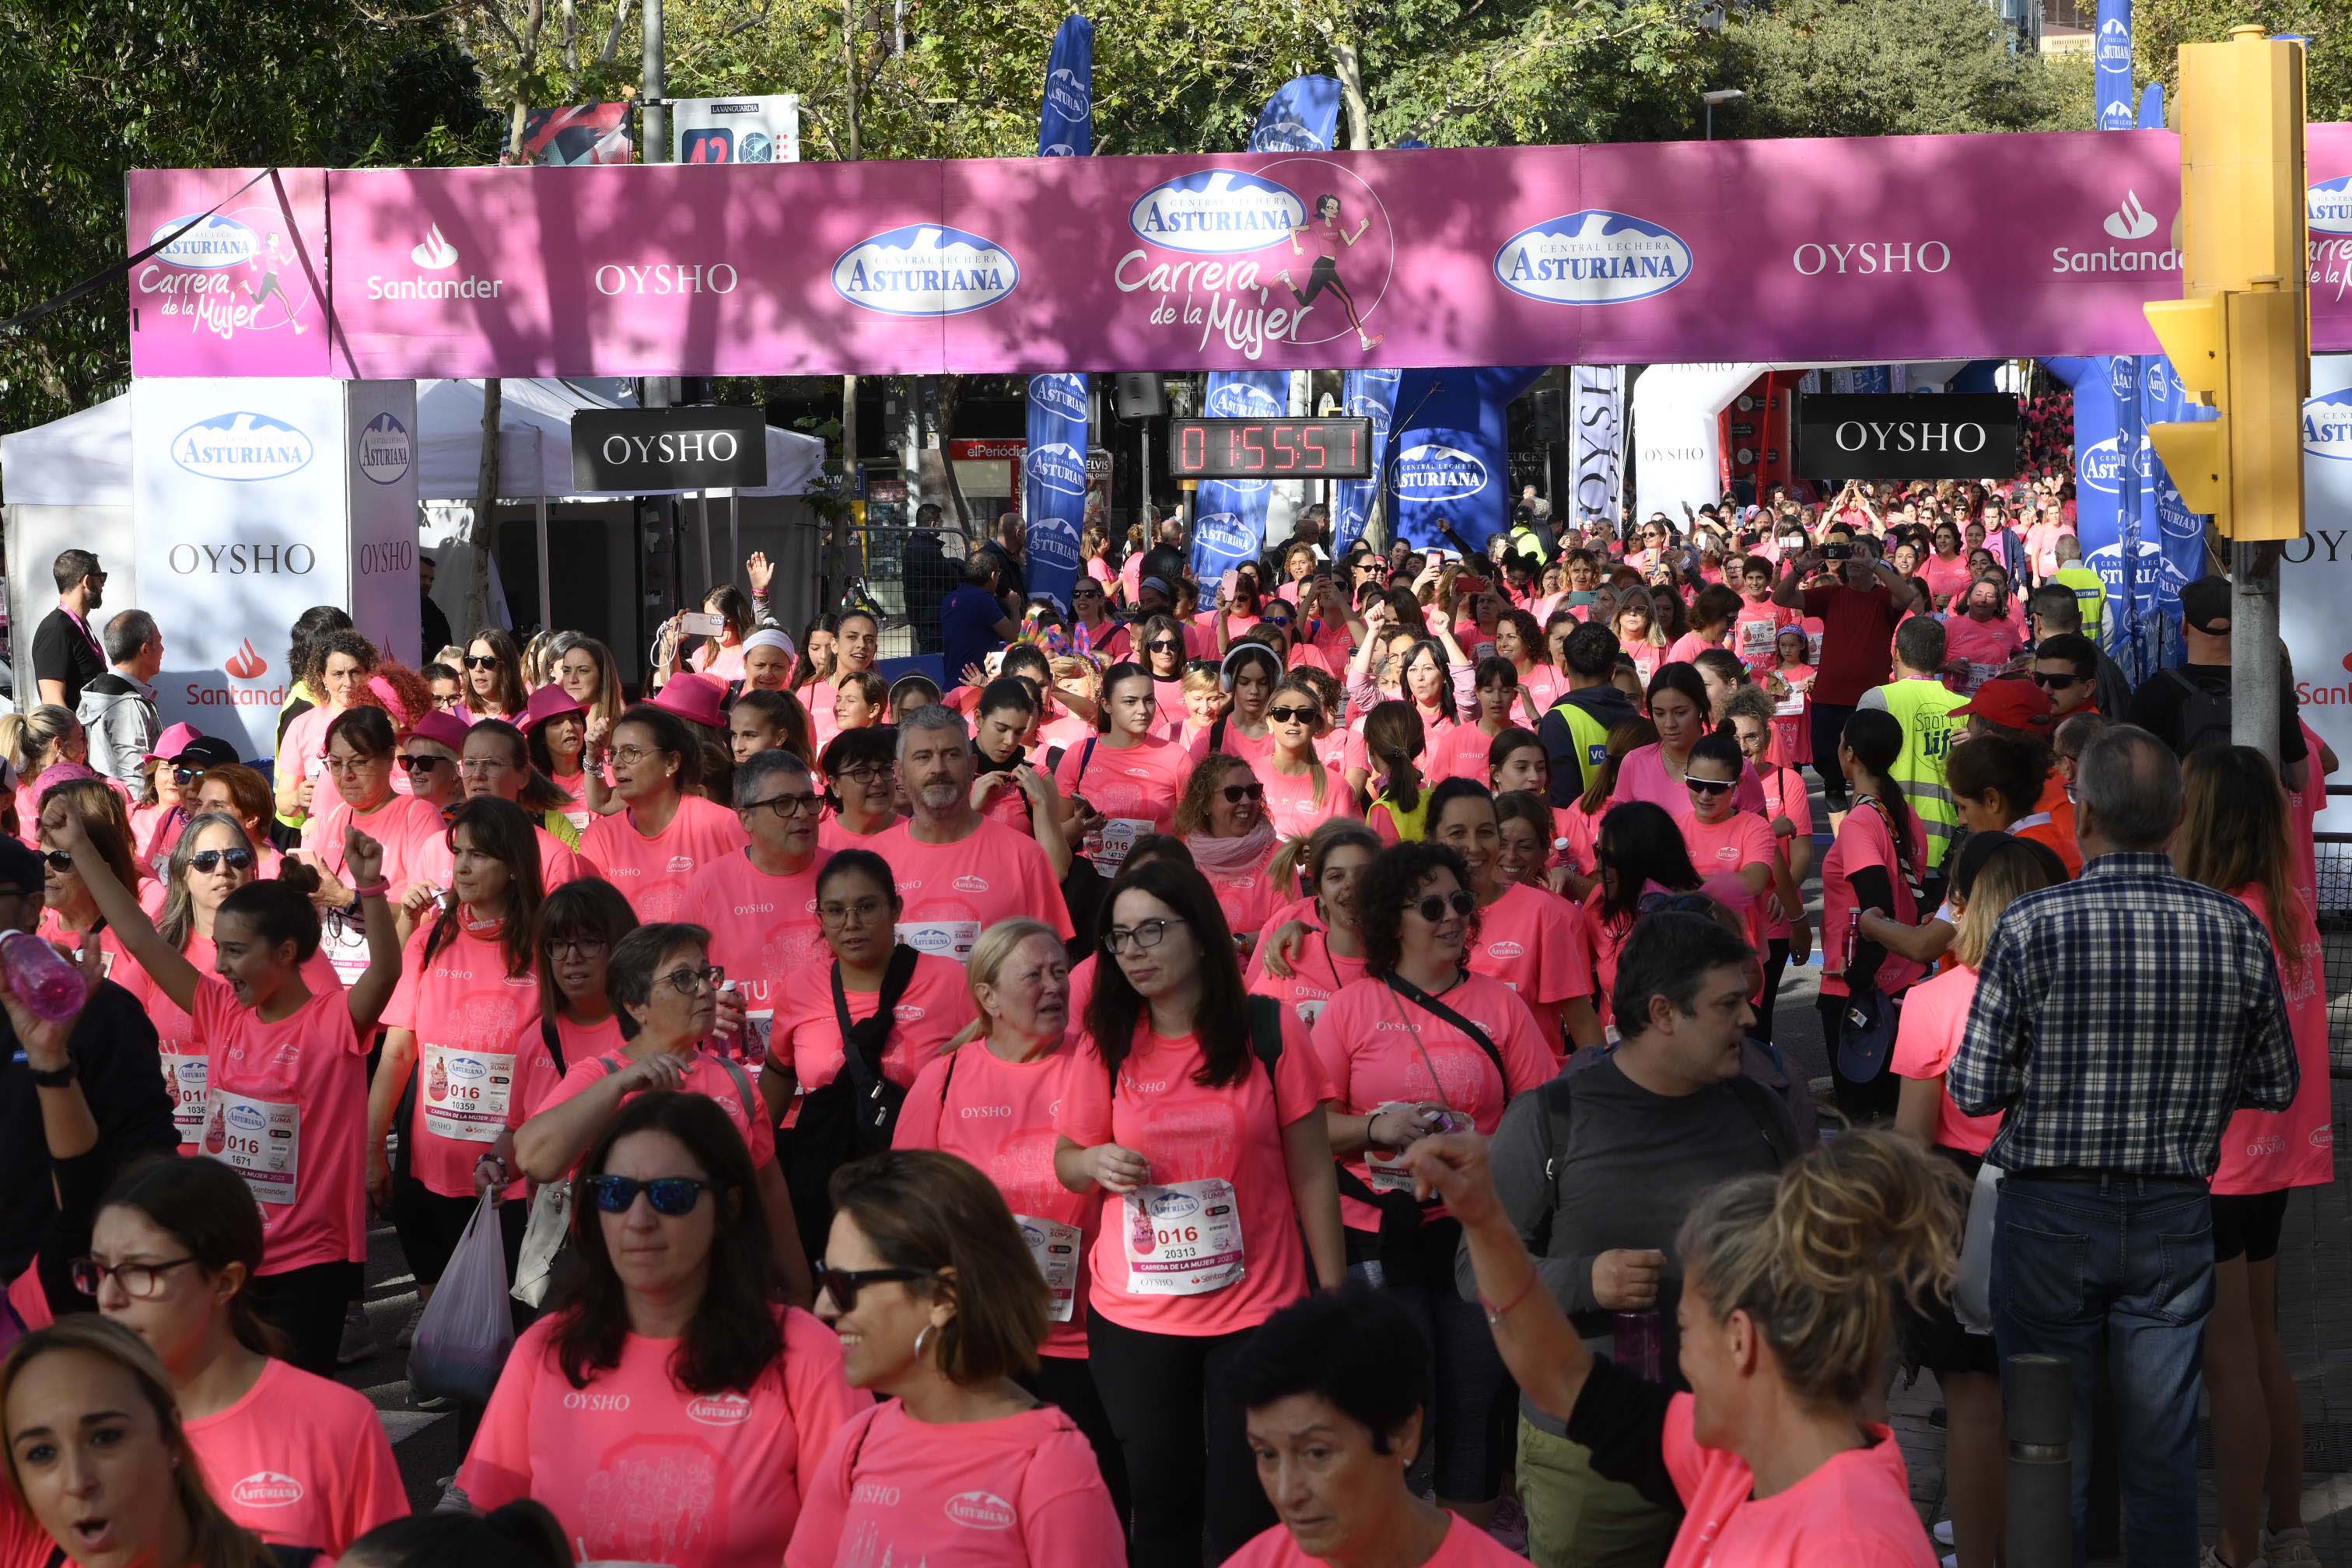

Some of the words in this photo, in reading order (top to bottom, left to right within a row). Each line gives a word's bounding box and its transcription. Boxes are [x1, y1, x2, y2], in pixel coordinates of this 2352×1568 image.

[1143, 201, 1293, 233] ASTURIANA
[1541, 243, 1601, 253] CENTRAL
[1607, 241, 1671, 251] LECHERA
[1509, 247, 1678, 282] ASTURIANA
[1793, 240, 1951, 276] OYSHO
[138, 264, 230, 293] Carrera
[594, 263, 739, 296] OYSHO
[845, 258, 1005, 292] ASTURIANA
[1115, 250, 1260, 293] Carrera
[367, 275, 503, 300] Santander
[161, 295, 177, 316] de
[182, 296, 194, 316] la
[192, 293, 264, 340] Mujer
[1150, 294, 1178, 325] de
[1183, 293, 1202, 325] la
[1199, 287, 1314, 360] Mujer
[1835, 421, 1986, 453] OYSHO
[184, 437, 303, 464] ASTURIANA
[362, 439, 408, 467] ASTURIANA
[603, 431, 738, 467] OYSHO
[1644, 447, 1704, 462] OYSHO
[1086, 460, 1108, 470] ELVIS
[1392, 467, 1480, 489] ASTURIANA
[2281, 530, 2352, 564] OY
[168, 544, 317, 575] OYSHO
[360, 540, 412, 576] OYSHO
[1106, 840, 1129, 851] 016
[733, 902, 774, 916] OYSHO
[913, 937, 948, 946] ASTURIANA
[436, 968, 473, 980] OYSHO
[451, 1063, 483, 1075] ASTURIANA
[450, 1083, 481, 1100] 016
[431, 1108, 453, 1118] CARRERA
[452, 1101, 476, 1111] 10359
[961, 1104, 1012, 1119] OYSHO
[227, 1113, 263, 1128] ASTURIANA
[270, 1116, 292, 1125] SUMA
[429, 1119, 451, 1131] OYSHO
[227, 1135, 260, 1155] 016
[2246, 1139, 2286, 1157] OYSHO
[231, 1154, 252, 1167] 1671
[247, 1170, 269, 1180] MUJER
[252, 1185, 287, 1196] Santander
[1202, 1191, 1227, 1201] SUMA
[1157, 1226, 1199, 1245] 016
[1164, 1247, 1197, 1259] 20313
[1140, 1263, 1169, 1272] CARRERA
[1190, 1258, 1215, 1269] MUJER
[1140, 1278, 1174, 1287] OYSHO
[562, 1392, 631, 1412] OYSHO
[236, 1484, 299, 1502] ASTURIANA
[953, 1500, 1010, 1523] ASTURIANA
